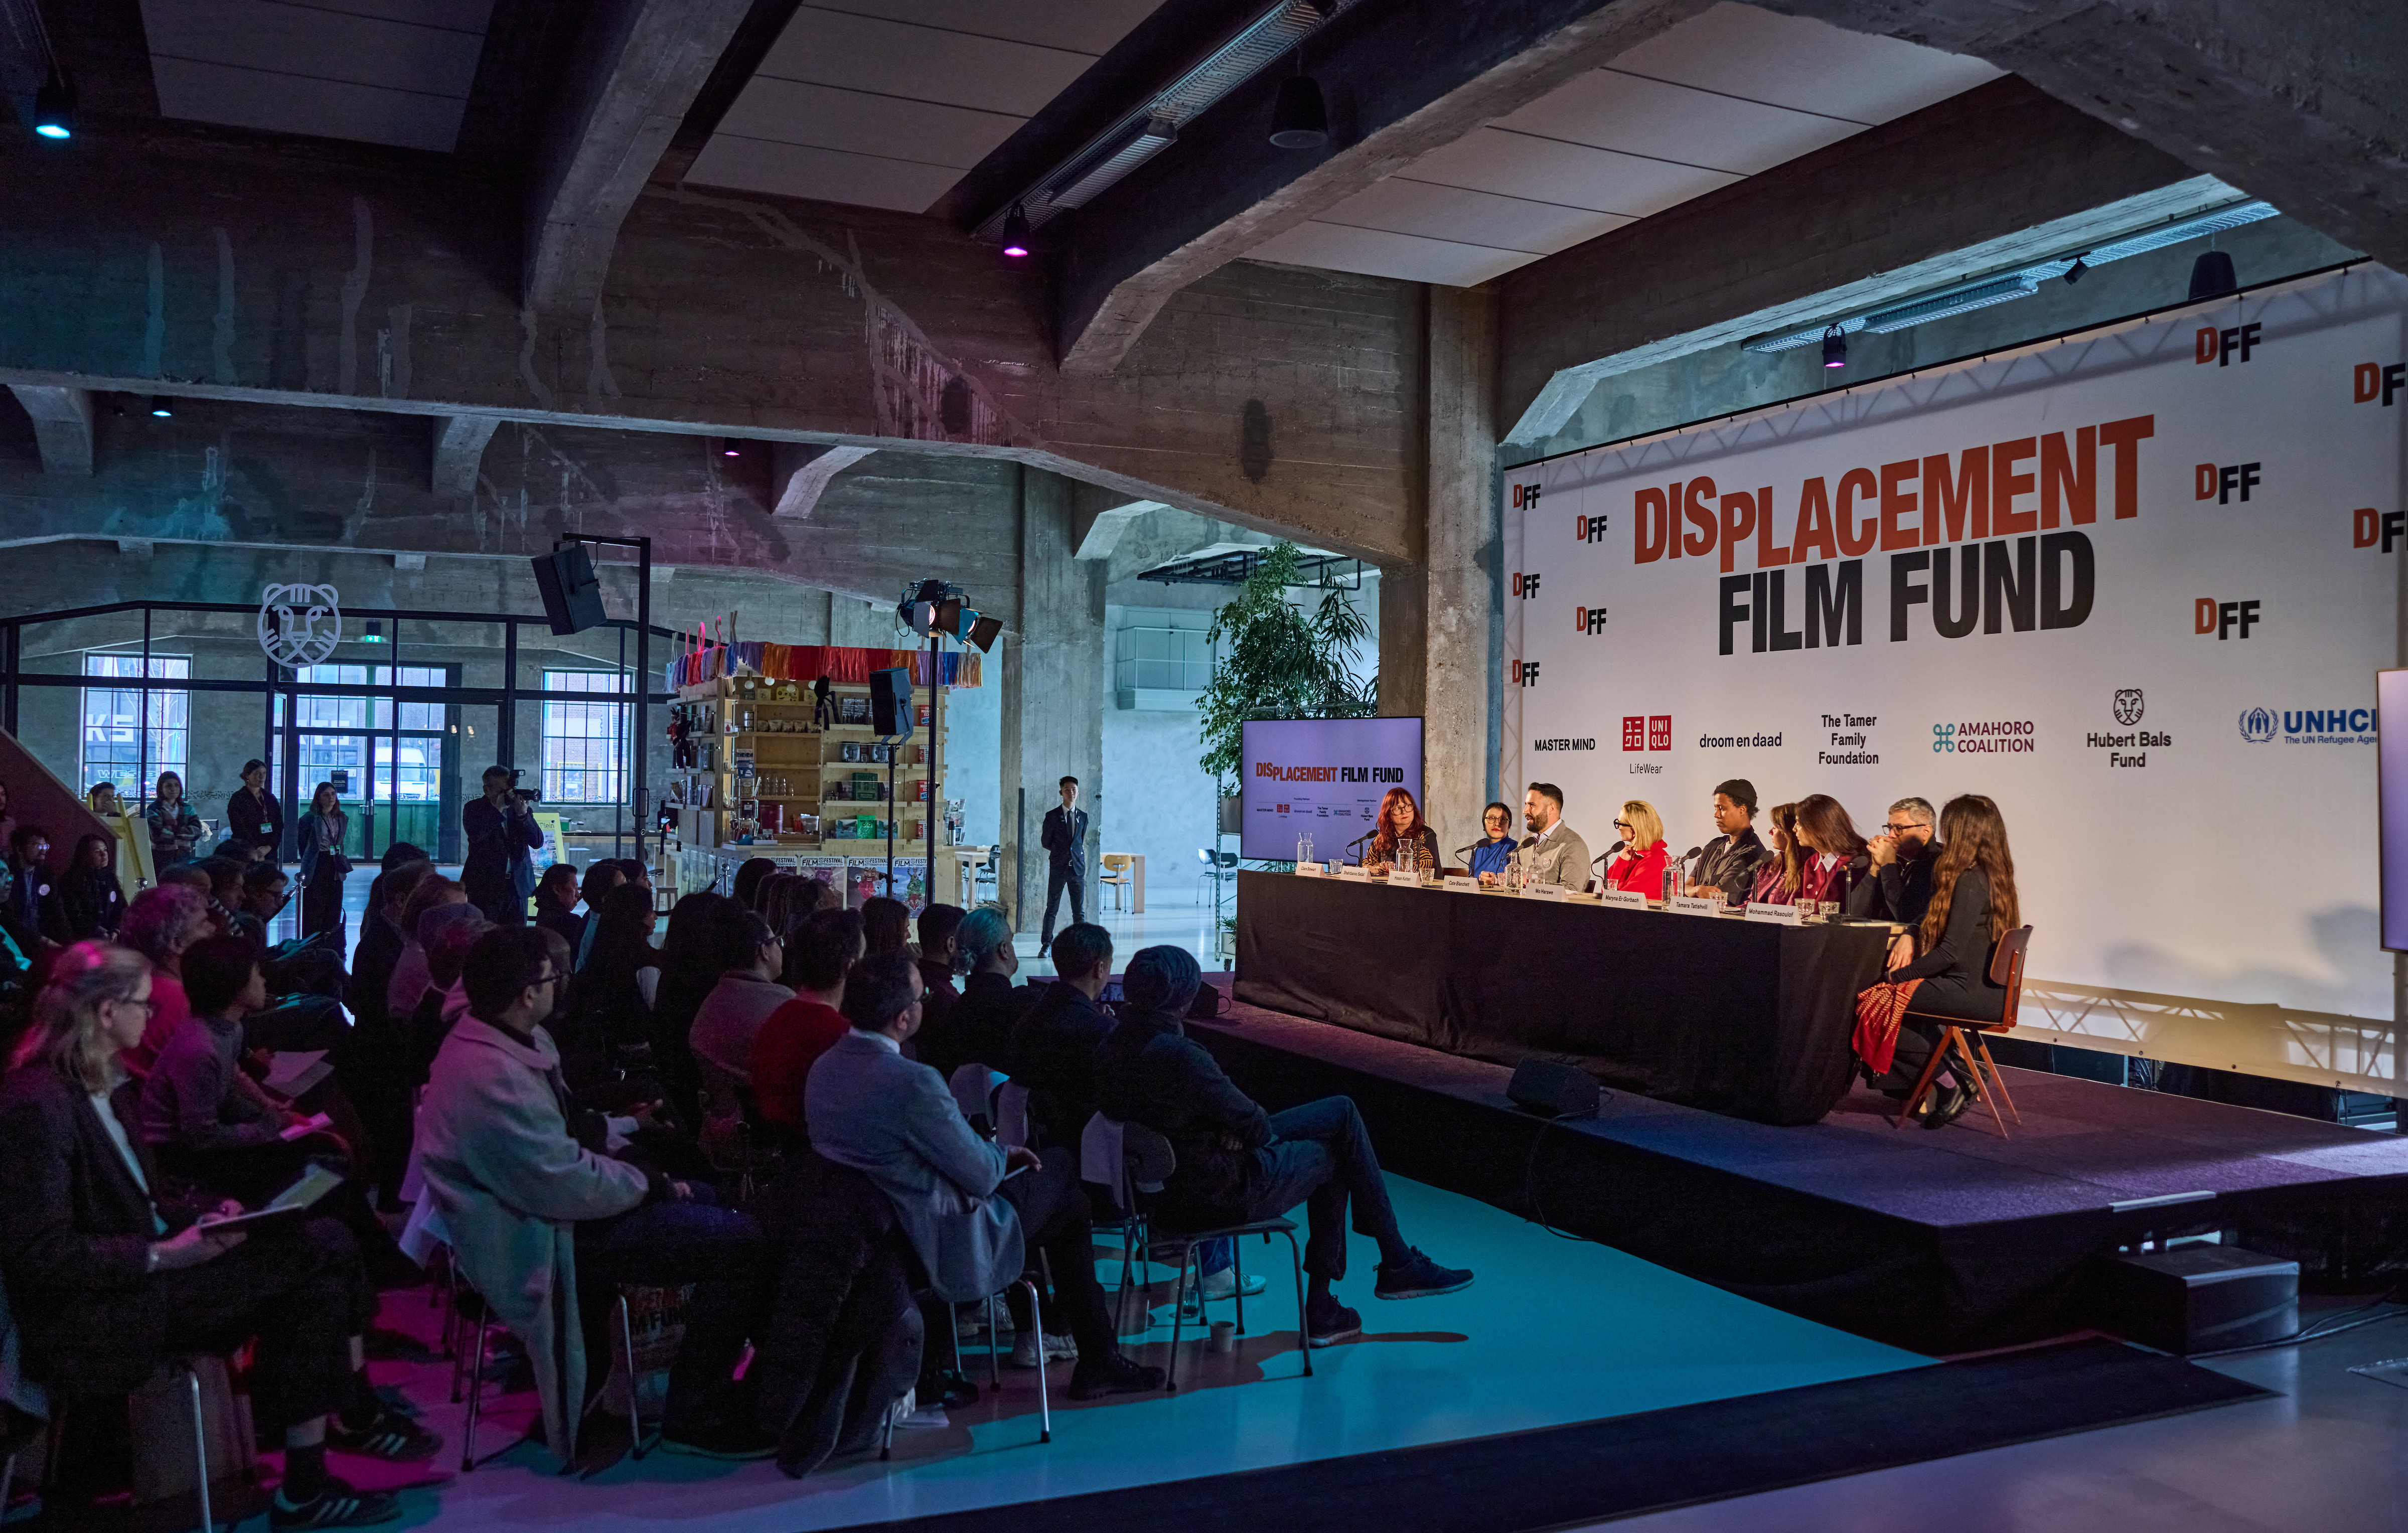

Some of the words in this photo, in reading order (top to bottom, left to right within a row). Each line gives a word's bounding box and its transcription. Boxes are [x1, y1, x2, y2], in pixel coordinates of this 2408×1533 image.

[2196, 322, 2262, 367] DFF
[2354, 362, 2408, 407] DF
[1635, 414, 2154, 573] DISPLACEMENT
[2195, 462, 2261, 505] DFF
[1514, 484, 1541, 511] DFF
[1577, 515, 1607, 544] DFF
[2353, 508, 2408, 553] DF
[1513, 572, 1540, 599] DFF
[1719, 558, 1862, 655] FILM
[1890, 531, 2094, 642] FUND
[1577, 606, 1607, 635] DFF
[2195, 597, 2260, 640] DFF
[1512, 659, 1540, 687] DFF
[1651, 720, 1668, 732] UNI
[1822, 715, 1841, 727] The
[1843, 714, 1877, 727] Tamer
[1959, 721, 2034, 736] AMAHORO
[2284, 709, 2377, 733] UNHC
[1535, 739, 1570, 751] MASTER
[1572, 738, 1595, 751] MIND
[1651, 734, 1669, 748] QLO
[1700, 734, 1734, 748] droom
[1736, 736, 1750, 747] en
[1753, 732, 1782, 747] daad
[1832, 732, 1866, 748] Family
[1958, 738, 2034, 753] COALITION
[2087, 732, 2136, 747] Hubert
[2139, 731, 2171, 747] Bals
[2284, 736, 2300, 744] The
[2302, 736, 2315, 744] UN
[2317, 735, 2354, 745] Refugee
[2357, 735, 2377, 745] Age
[1819, 751, 1879, 764] Foundation
[2111, 752, 2146, 768] Fund
[1256, 762, 1337, 782] DISPLACEMENT
[1341, 768, 1368, 782] FILM
[1373, 768, 1404, 783] FUND
[1630, 763, 1663, 774] LifeWear
